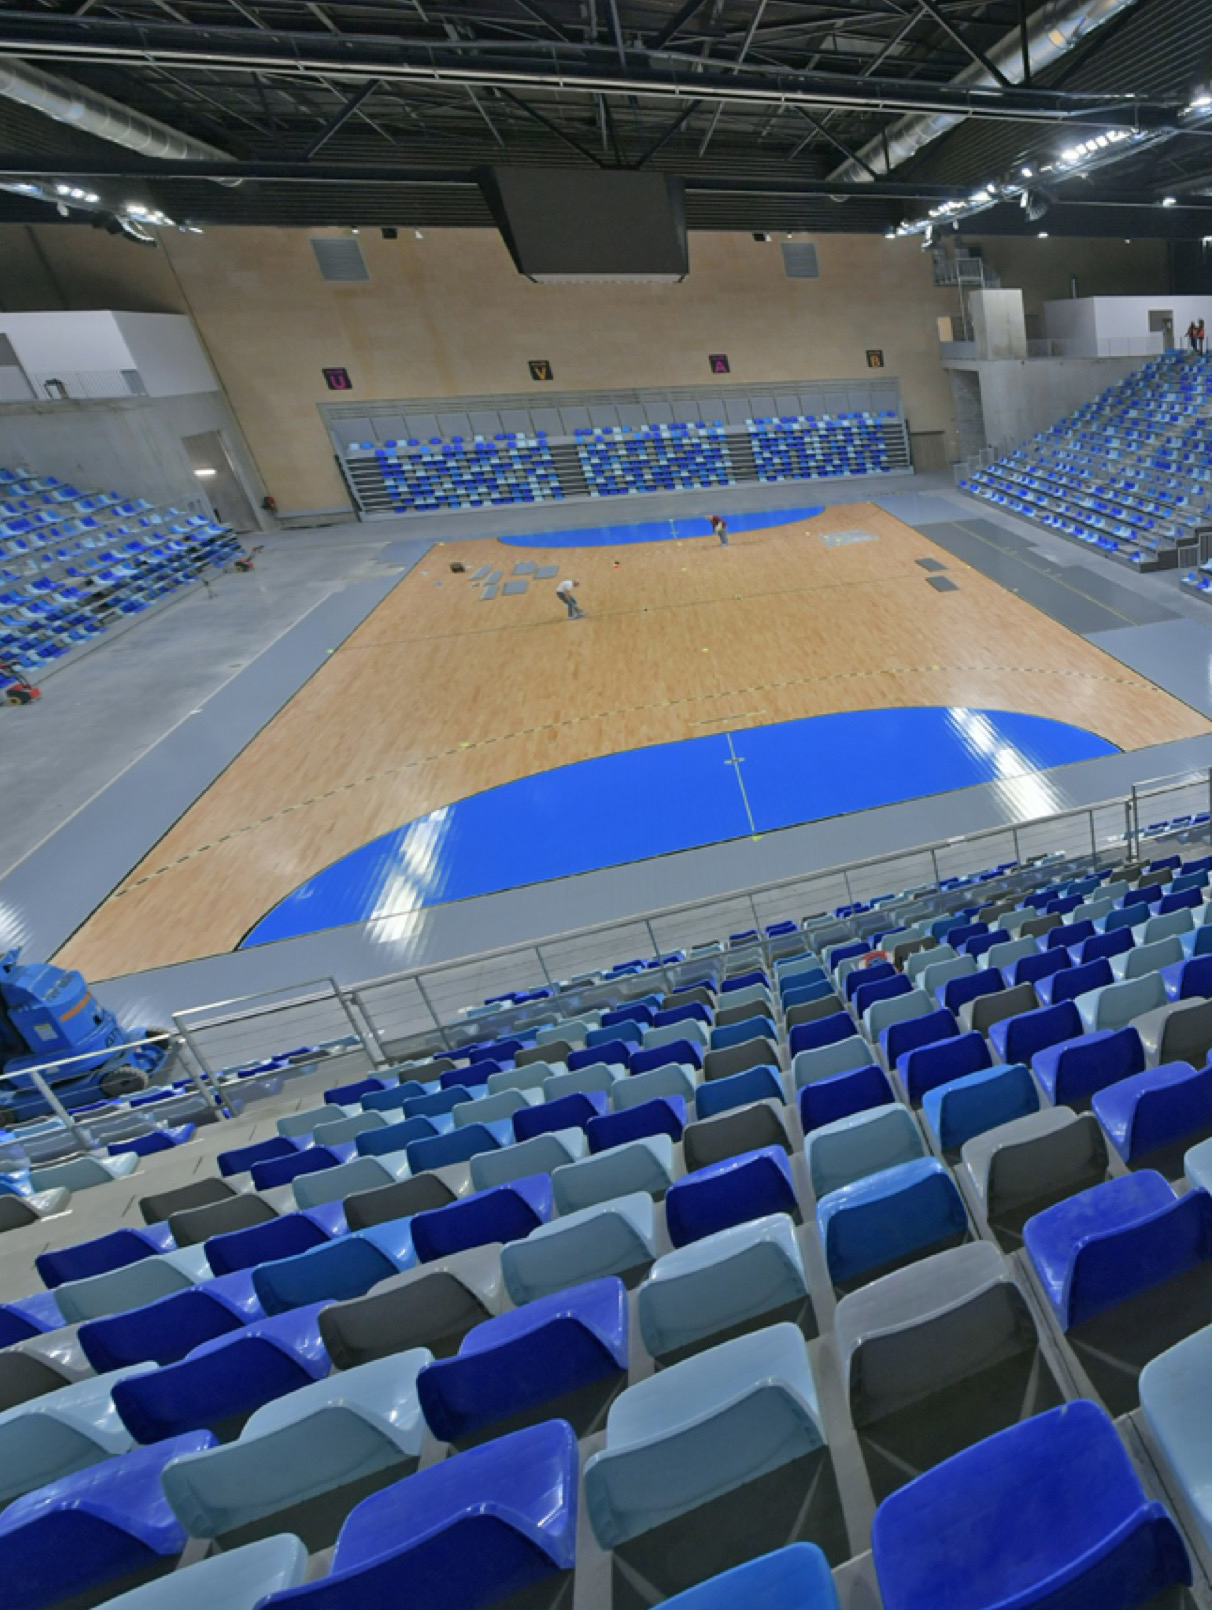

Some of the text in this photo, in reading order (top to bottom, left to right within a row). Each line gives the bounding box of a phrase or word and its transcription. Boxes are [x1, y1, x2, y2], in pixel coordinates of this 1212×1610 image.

[534, 366, 547, 380] V
[714, 360, 727, 373] A
[331, 375, 346, 389] U
